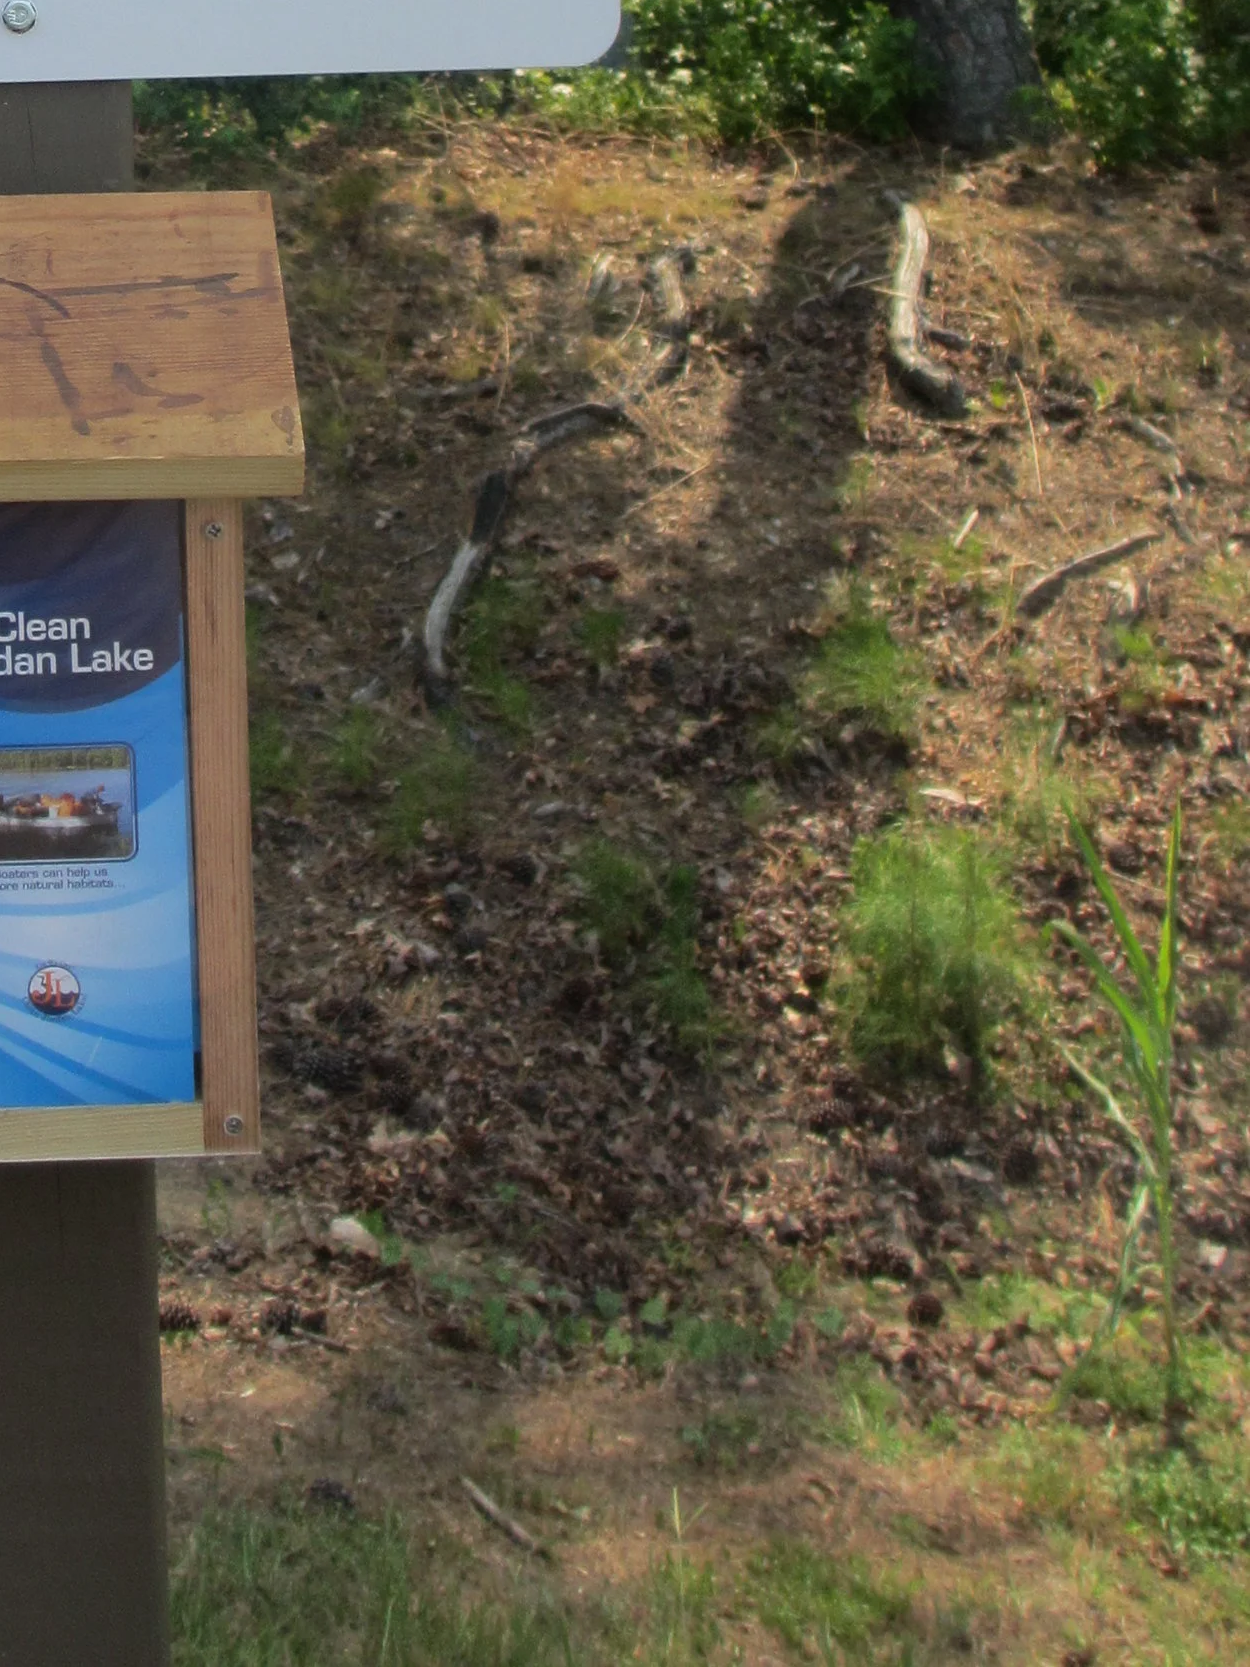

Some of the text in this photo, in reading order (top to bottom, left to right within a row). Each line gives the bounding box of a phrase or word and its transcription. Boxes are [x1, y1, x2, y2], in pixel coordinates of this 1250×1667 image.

[70, 641, 154, 674] Lake
[43, 869, 63, 877] can
[67, 867, 90, 879] help
[22, 880, 63, 889] natural
